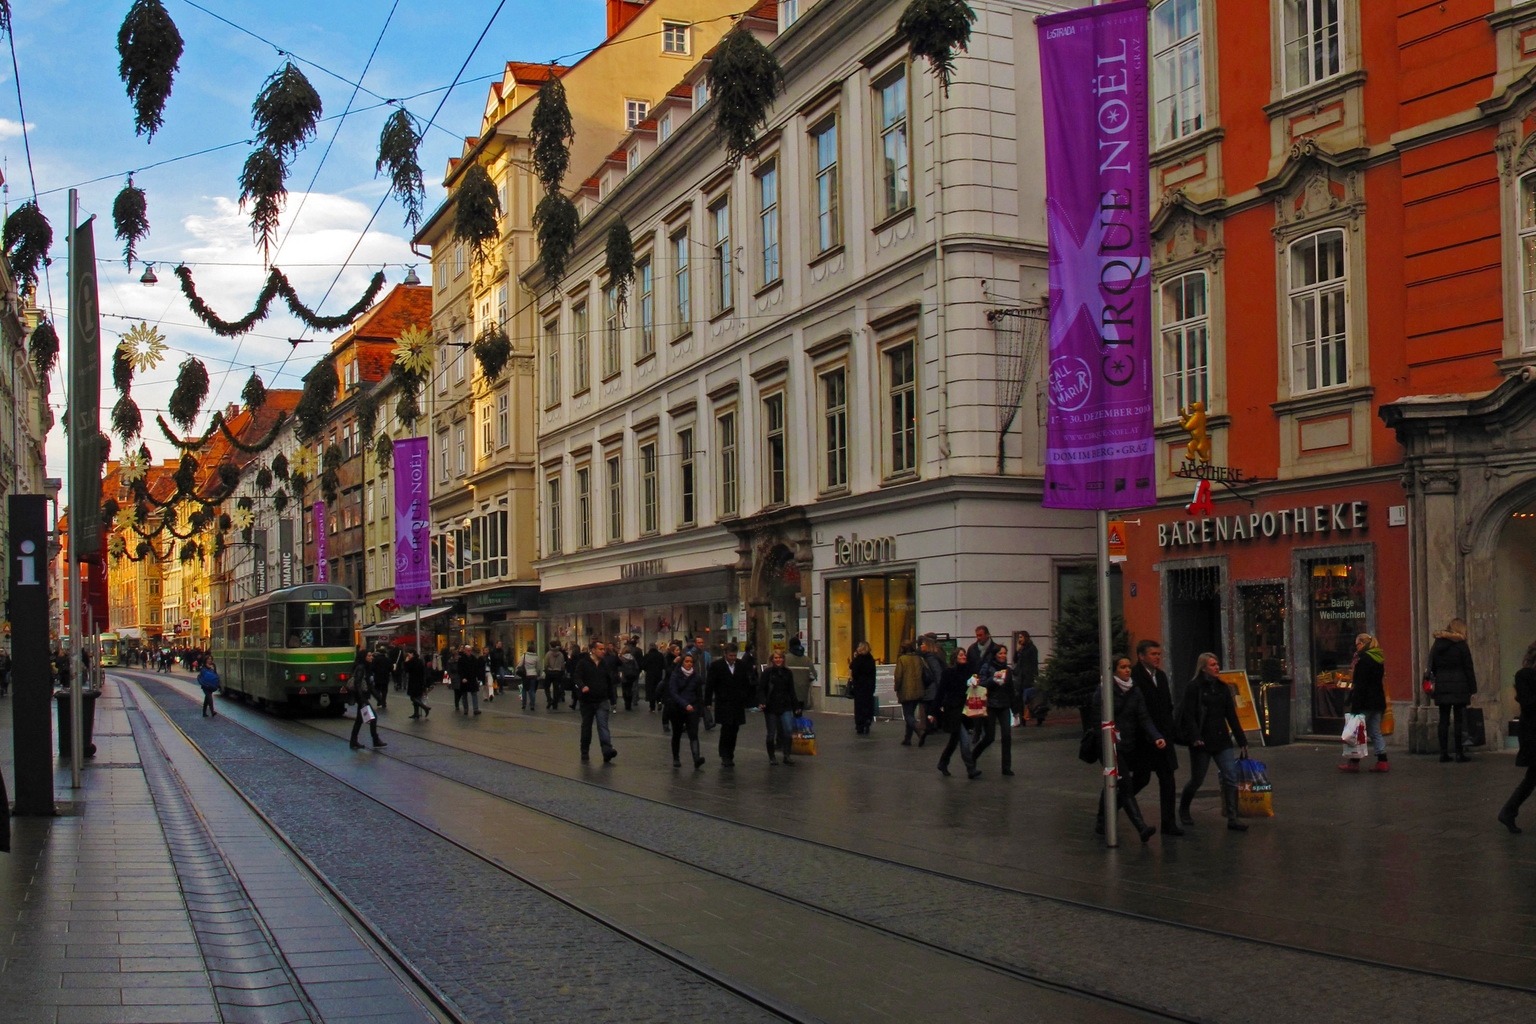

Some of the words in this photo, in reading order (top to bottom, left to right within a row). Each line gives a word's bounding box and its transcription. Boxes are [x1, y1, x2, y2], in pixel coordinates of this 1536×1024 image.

[1133, 37, 1141, 70] GRAZ
[1091, 38, 1131, 175] NOËL
[1100, 187, 1142, 387] CIRQUE
[1049, 365, 1072, 385] CALL
[1052, 381, 1066, 393] ME
[1083, 406, 1133, 423] DEZEMBER
[1053, 451, 1077, 461] DOM
[1078, 450, 1091, 460] IM
[1091, 446, 1115, 459] BERG
[1121, 442, 1148, 455] GRAZ
[1179, 461, 1243, 481] APOTHEKE
[1157, 501, 1369, 547] BÄRENAPOTHEKE
[257, 560, 265, 594] UMANIC
[282, 552, 292, 589] UMANIC
[1331, 598, 1355, 610] Bärige
[1319, 609, 1366, 620] Weihnachten
